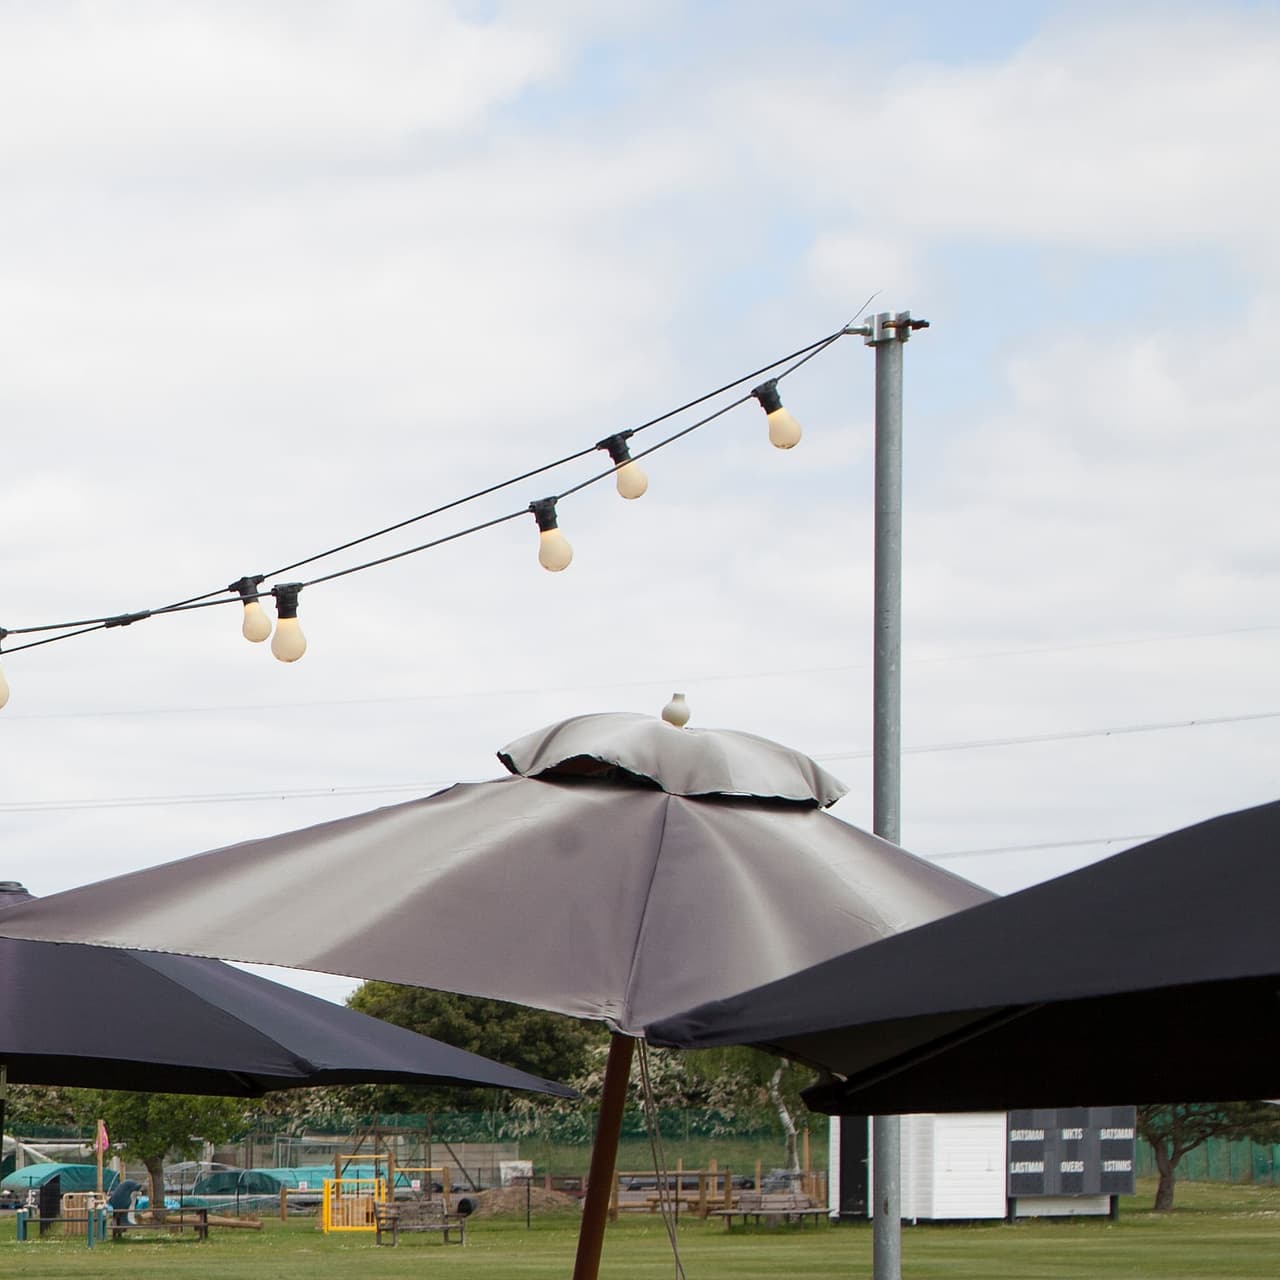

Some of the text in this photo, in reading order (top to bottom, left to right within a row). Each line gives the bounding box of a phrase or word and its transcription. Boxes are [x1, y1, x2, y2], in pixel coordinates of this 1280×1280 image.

[1010, 1128, 1134, 1141] BATSMAN WKTS BATSMAN
[1060, 1161, 1084, 1173] OVERS
